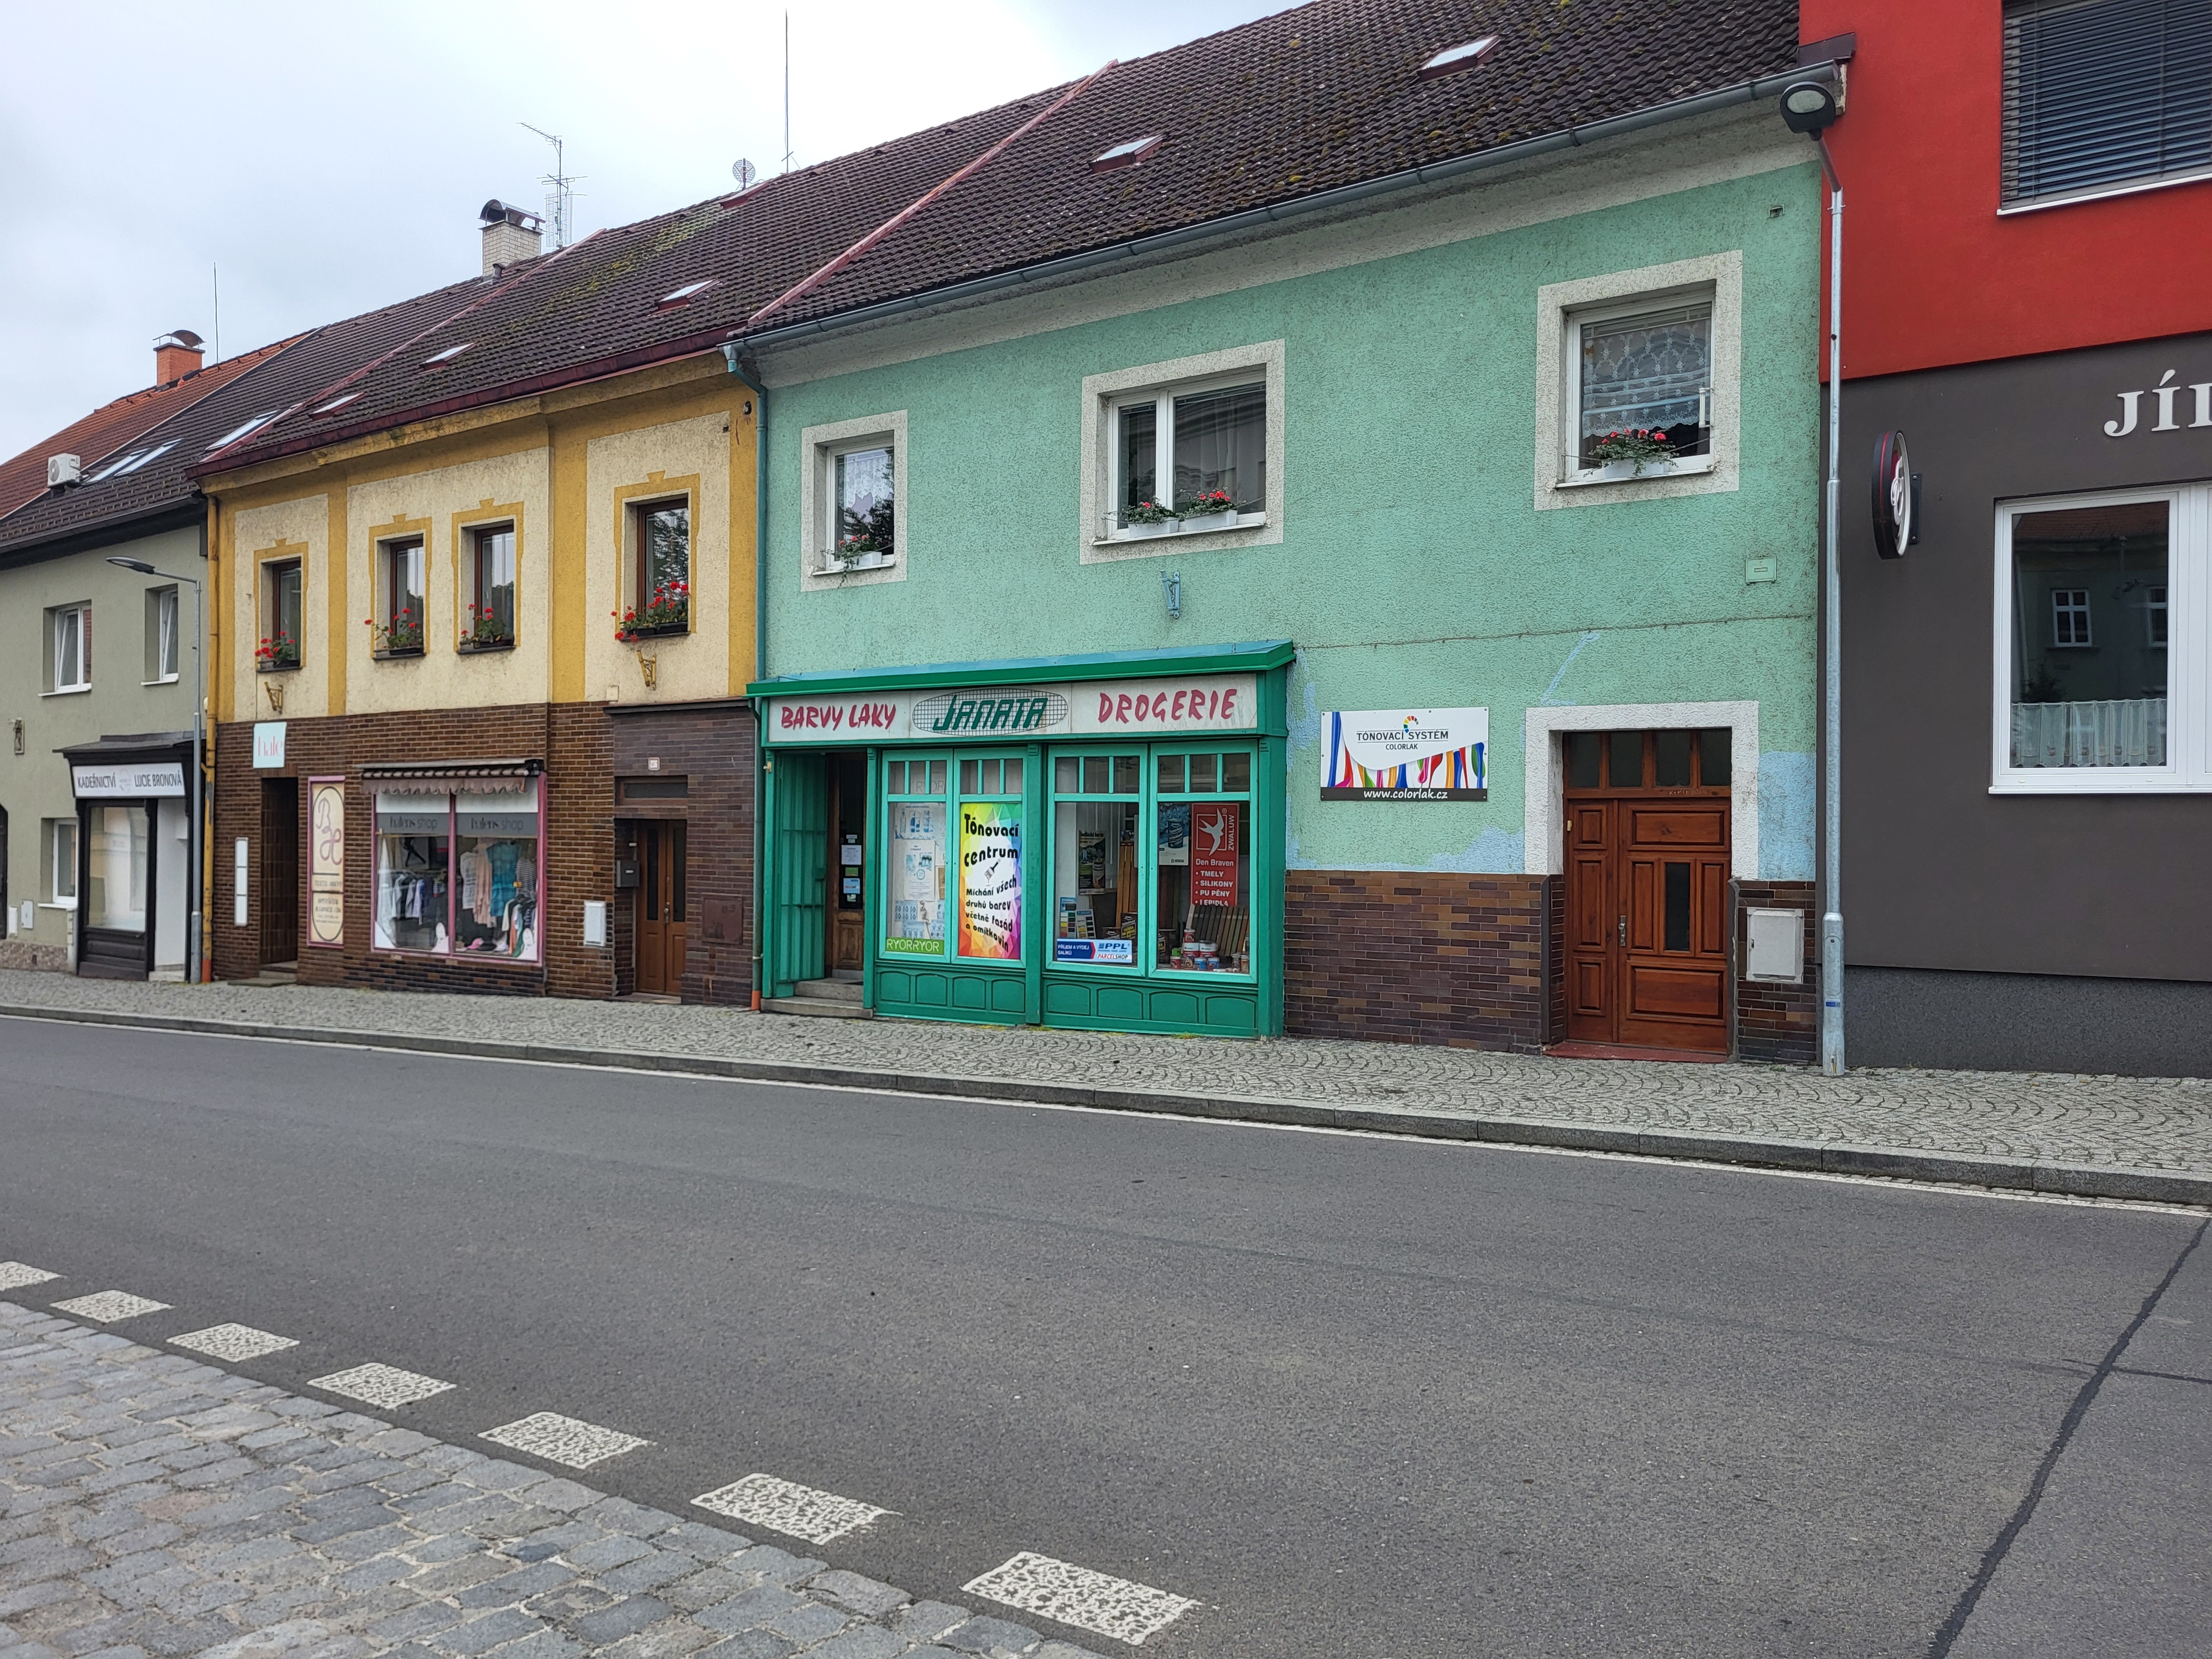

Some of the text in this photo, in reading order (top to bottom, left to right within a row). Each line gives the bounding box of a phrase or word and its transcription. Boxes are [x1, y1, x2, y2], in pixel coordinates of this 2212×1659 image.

[2104, 369, 2212, 437] JÍ
[781, 703, 896, 731] BARVY LAKY
[932, 695, 1048, 731] JANATA
[1098, 688, 1238, 724] DROGERIE
[1357, 729, 1449, 741] TÓNOVACÍ SYSTÉM
[77, 772, 116, 789] KADEŘNICTVÍ
[134, 774, 151, 787] LUCIE
[152, 770, 182, 787] BRONOVÁ
[1364, 787, 1448, 799] www.colorlak.cz
[964, 813, 1020, 837] Tónovací
[964, 846, 1018, 867] centrum
[966, 874, 1017, 896] Míchání všech
[1211, 889, 1230, 897] PĚNY
[966, 900, 1011, 910] druhů barev
[966, 911, 1013, 933] včetně fasád
[973, 925, 1009, 952] omítkovin
